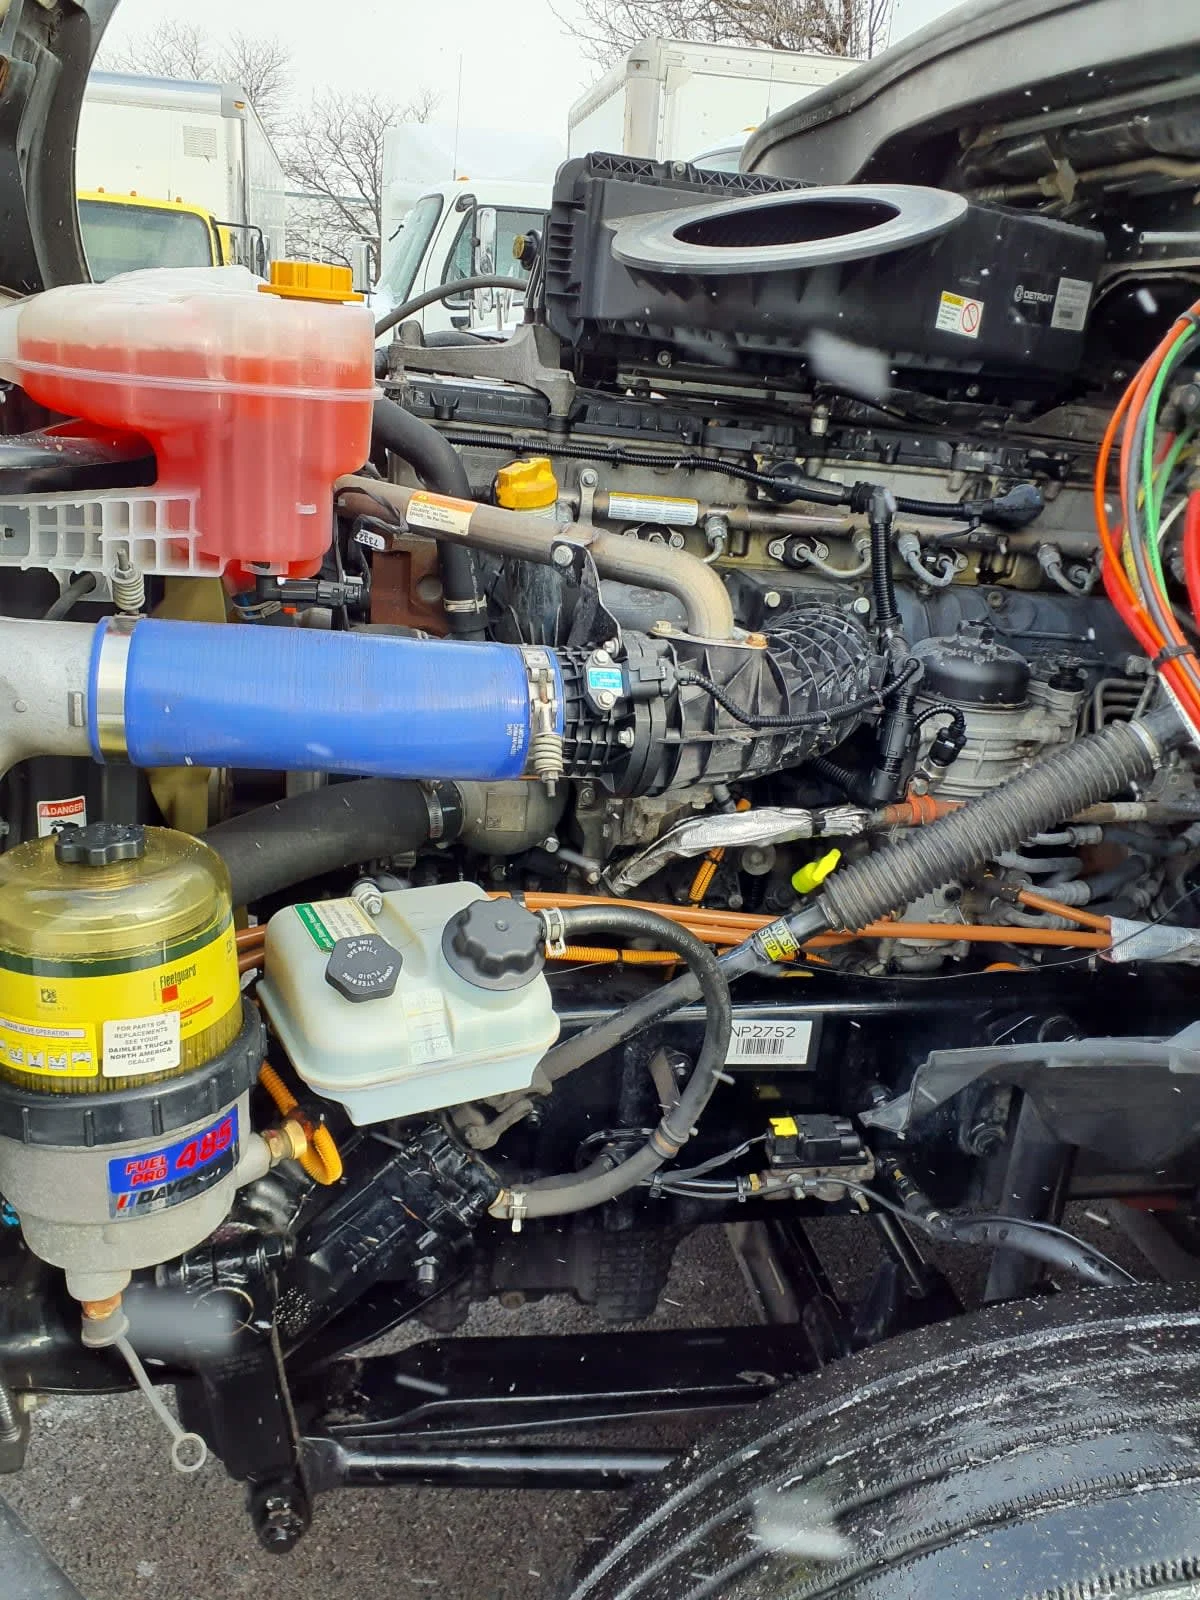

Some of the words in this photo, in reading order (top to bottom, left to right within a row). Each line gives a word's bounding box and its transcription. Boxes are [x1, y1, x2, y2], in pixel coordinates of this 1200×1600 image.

[1023, 290, 1054, 303] DETROIT
[50, 803, 83, 816] DANGER
[347, 941, 357, 949] DO
[760, 929, 778, 951] STEP
[346, 946, 378, 959] OVERFILL
[160, 963, 197, 989] Fleetguard
[342, 972, 375, 987] STEERING
[358, 969, 382, 979] FLUID
[379, 965, 394, 983] POWER
[116, 1024, 131, 1032] FOR
[132, 1022, 155, 1030] PARTS
[156, 1019, 166, 1027] OR
[35, 1028, 70, 1037] OPERATION
[114, 1026, 168, 1039] REPLACEMENTS
[108, 1045, 142, 1053] DAIMLER
[144, 1039, 174, 1049] TRUCKS
[125, 1038, 138, 1046] SEE
[139, 1035, 159, 1043] YOUR
[138, 1046, 172, 1057] AMERICA
[127, 1057, 156, 1066] DEALER
[126, 1154, 168, 1175] FUEL
[175, 1116, 233, 1170] 485
[130, 1167, 168, 1187] PRO
